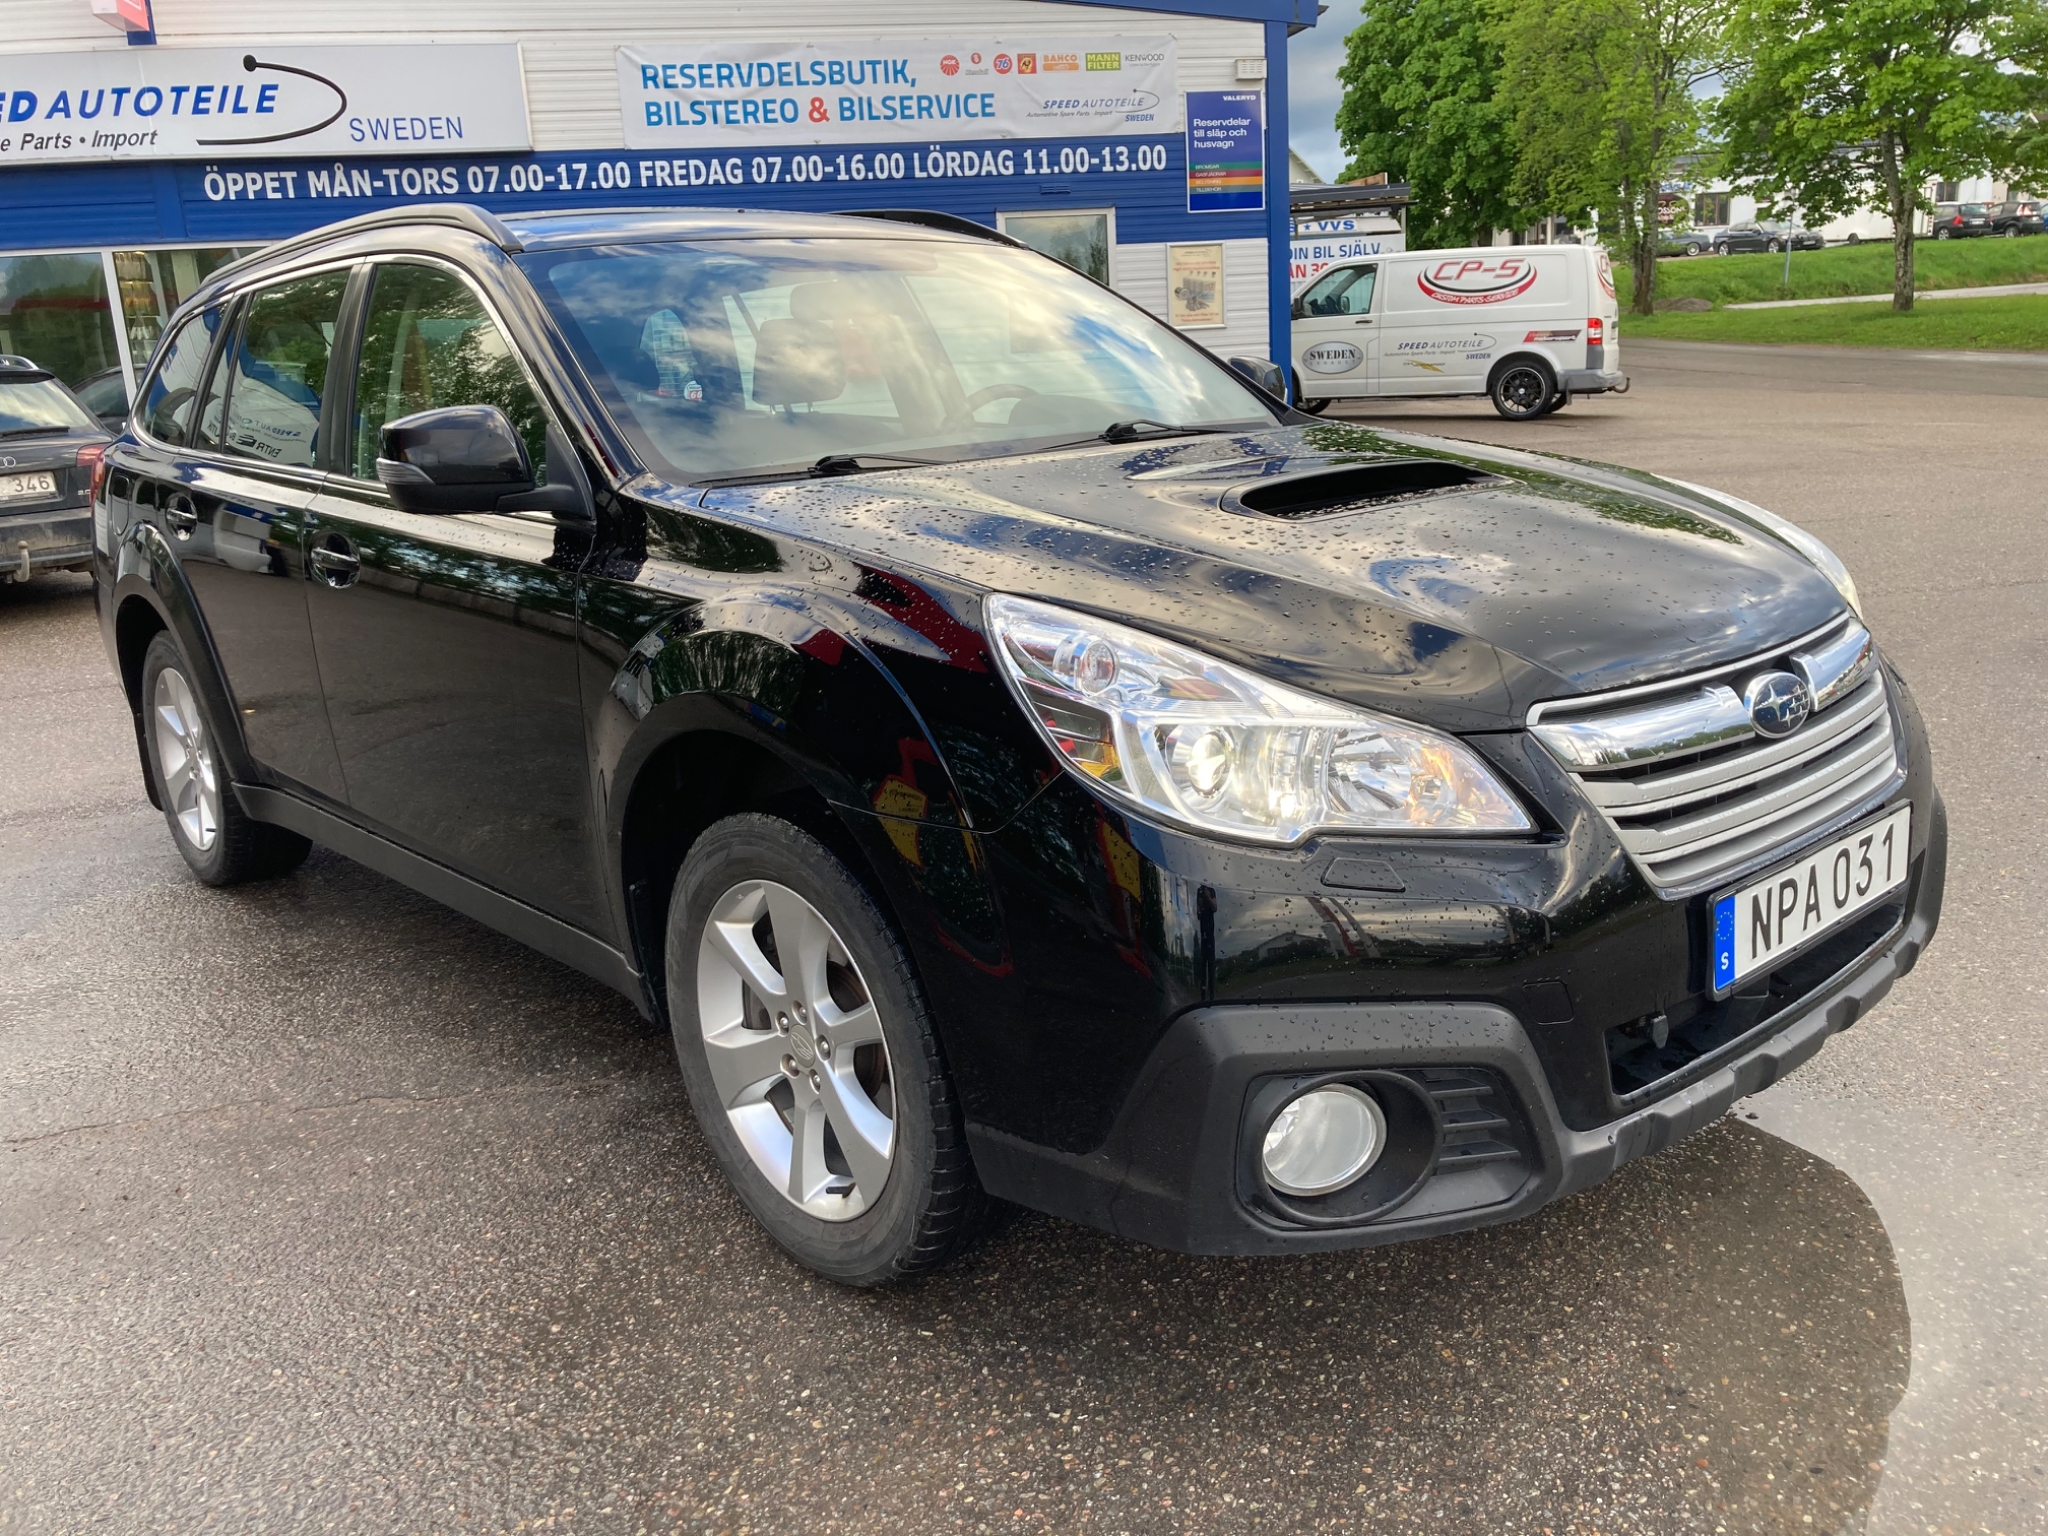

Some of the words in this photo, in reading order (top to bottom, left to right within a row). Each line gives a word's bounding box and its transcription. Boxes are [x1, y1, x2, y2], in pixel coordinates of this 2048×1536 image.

[996, 58, 1009, 68] 76
[1043, 54, 1078, 62] BAHCO
[1125, 53, 1165, 62] KENWOOD
[1087, 61, 1120, 69] FILTER
[641, 58, 916, 91] RESERVDELSBUTIK,
[44, 84, 279, 119] AUTOTEILE
[1043, 99, 1080, 109] SPEED
[1082, 97, 1145, 108] AUTOTEILE
[645, 98, 799, 127] BILSTEREO
[809, 97, 829, 123] &
[838, 93, 995, 122] BILSERVICE
[1125, 114, 1155, 122] SWEDEN
[1193, 118, 1251, 127] Reservdelar
[350, 117, 463, 142] SWEDEN
[1193, 129, 1205, 137] till
[1206, 129, 1227, 138] släp
[1228, 128, 1247, 136] och
[20, 132, 72, 151] Parts
[91, 130, 158, 151] Import
[1194, 140, 1235, 149] husvagn
[204, 166, 298, 201] ÖPPET
[307, 163, 459, 198] MÅN-TORS
[467, 161, 631, 194] 07.00-17.00
[639, 157, 744, 187] FREDAG
[751, 151, 905, 183] 07.00-16.00
[912, 143, 1014, 179] LÖRDAG
[1023, 144, 1167, 175] 11.00-13.00
[1317, 219, 1356, 232] VVS
[1313, 245, 1335, 259] BIL
[1339, 239, 1381, 258] SJÄLV
[1433, 258, 1526, 281] CP-S
[1397, 342, 1429, 350] SPEED
[1430, 340, 1484, 349] AUTOTEILE
[1309, 349, 1356, 360] SWEDEN
[13, 474, 50, 493] 346
[1751, 863, 1822, 960] NPA
[1832, 822, 1895, 910] 031
[1720, 951, 1730, 971] S
